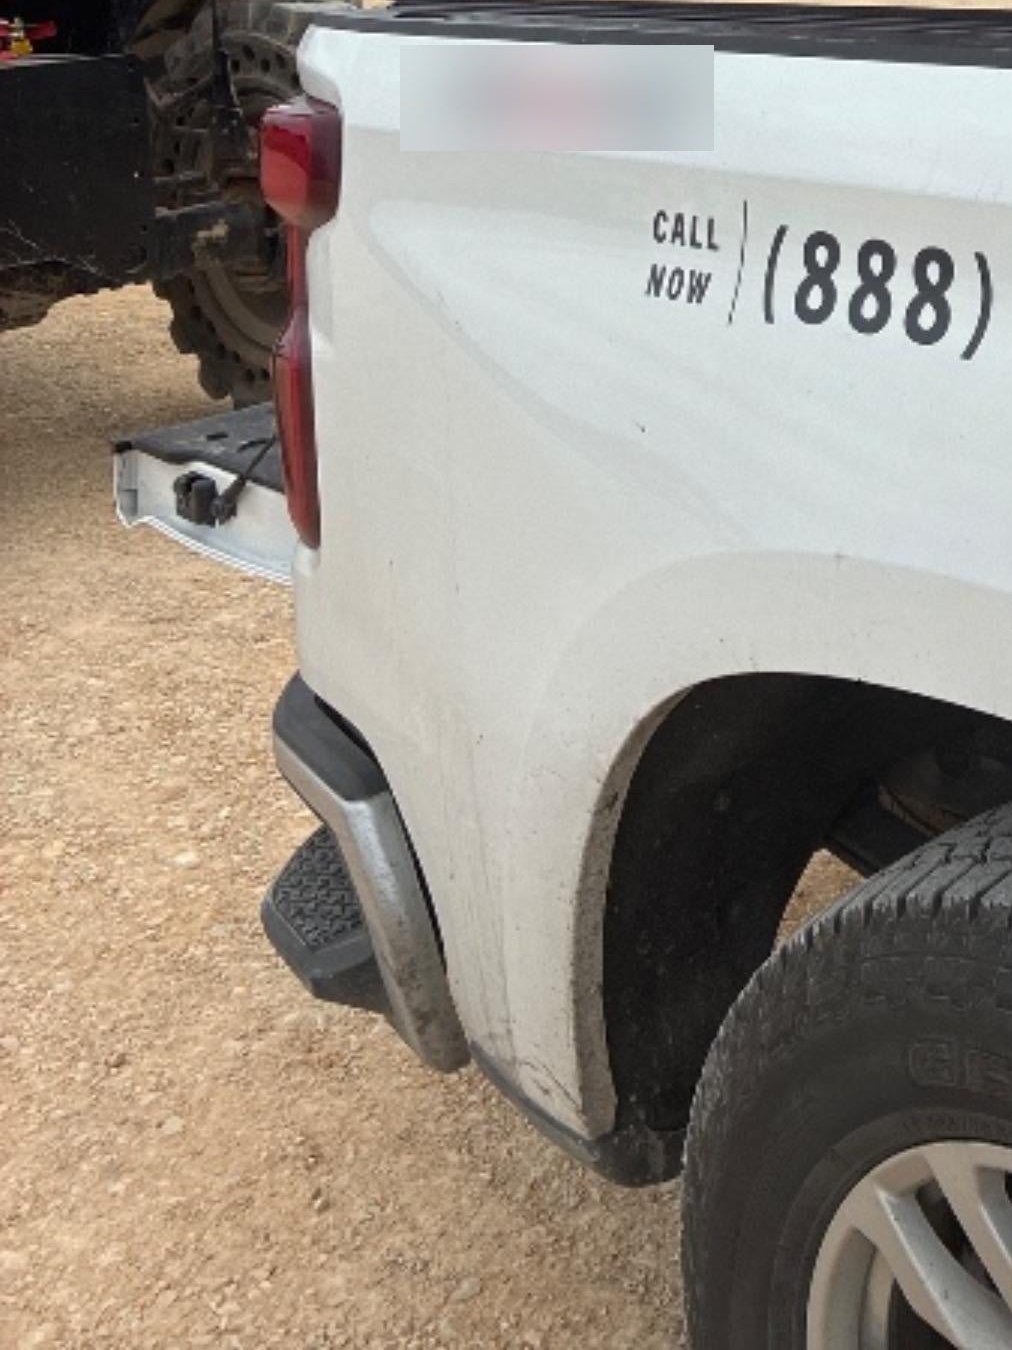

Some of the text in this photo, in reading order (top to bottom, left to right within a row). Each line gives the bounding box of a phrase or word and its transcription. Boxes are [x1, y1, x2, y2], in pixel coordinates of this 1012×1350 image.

[653, 209, 719, 252] CALL
[646, 263, 712, 304] NOW
[764, 224, 993, 361] (888)
